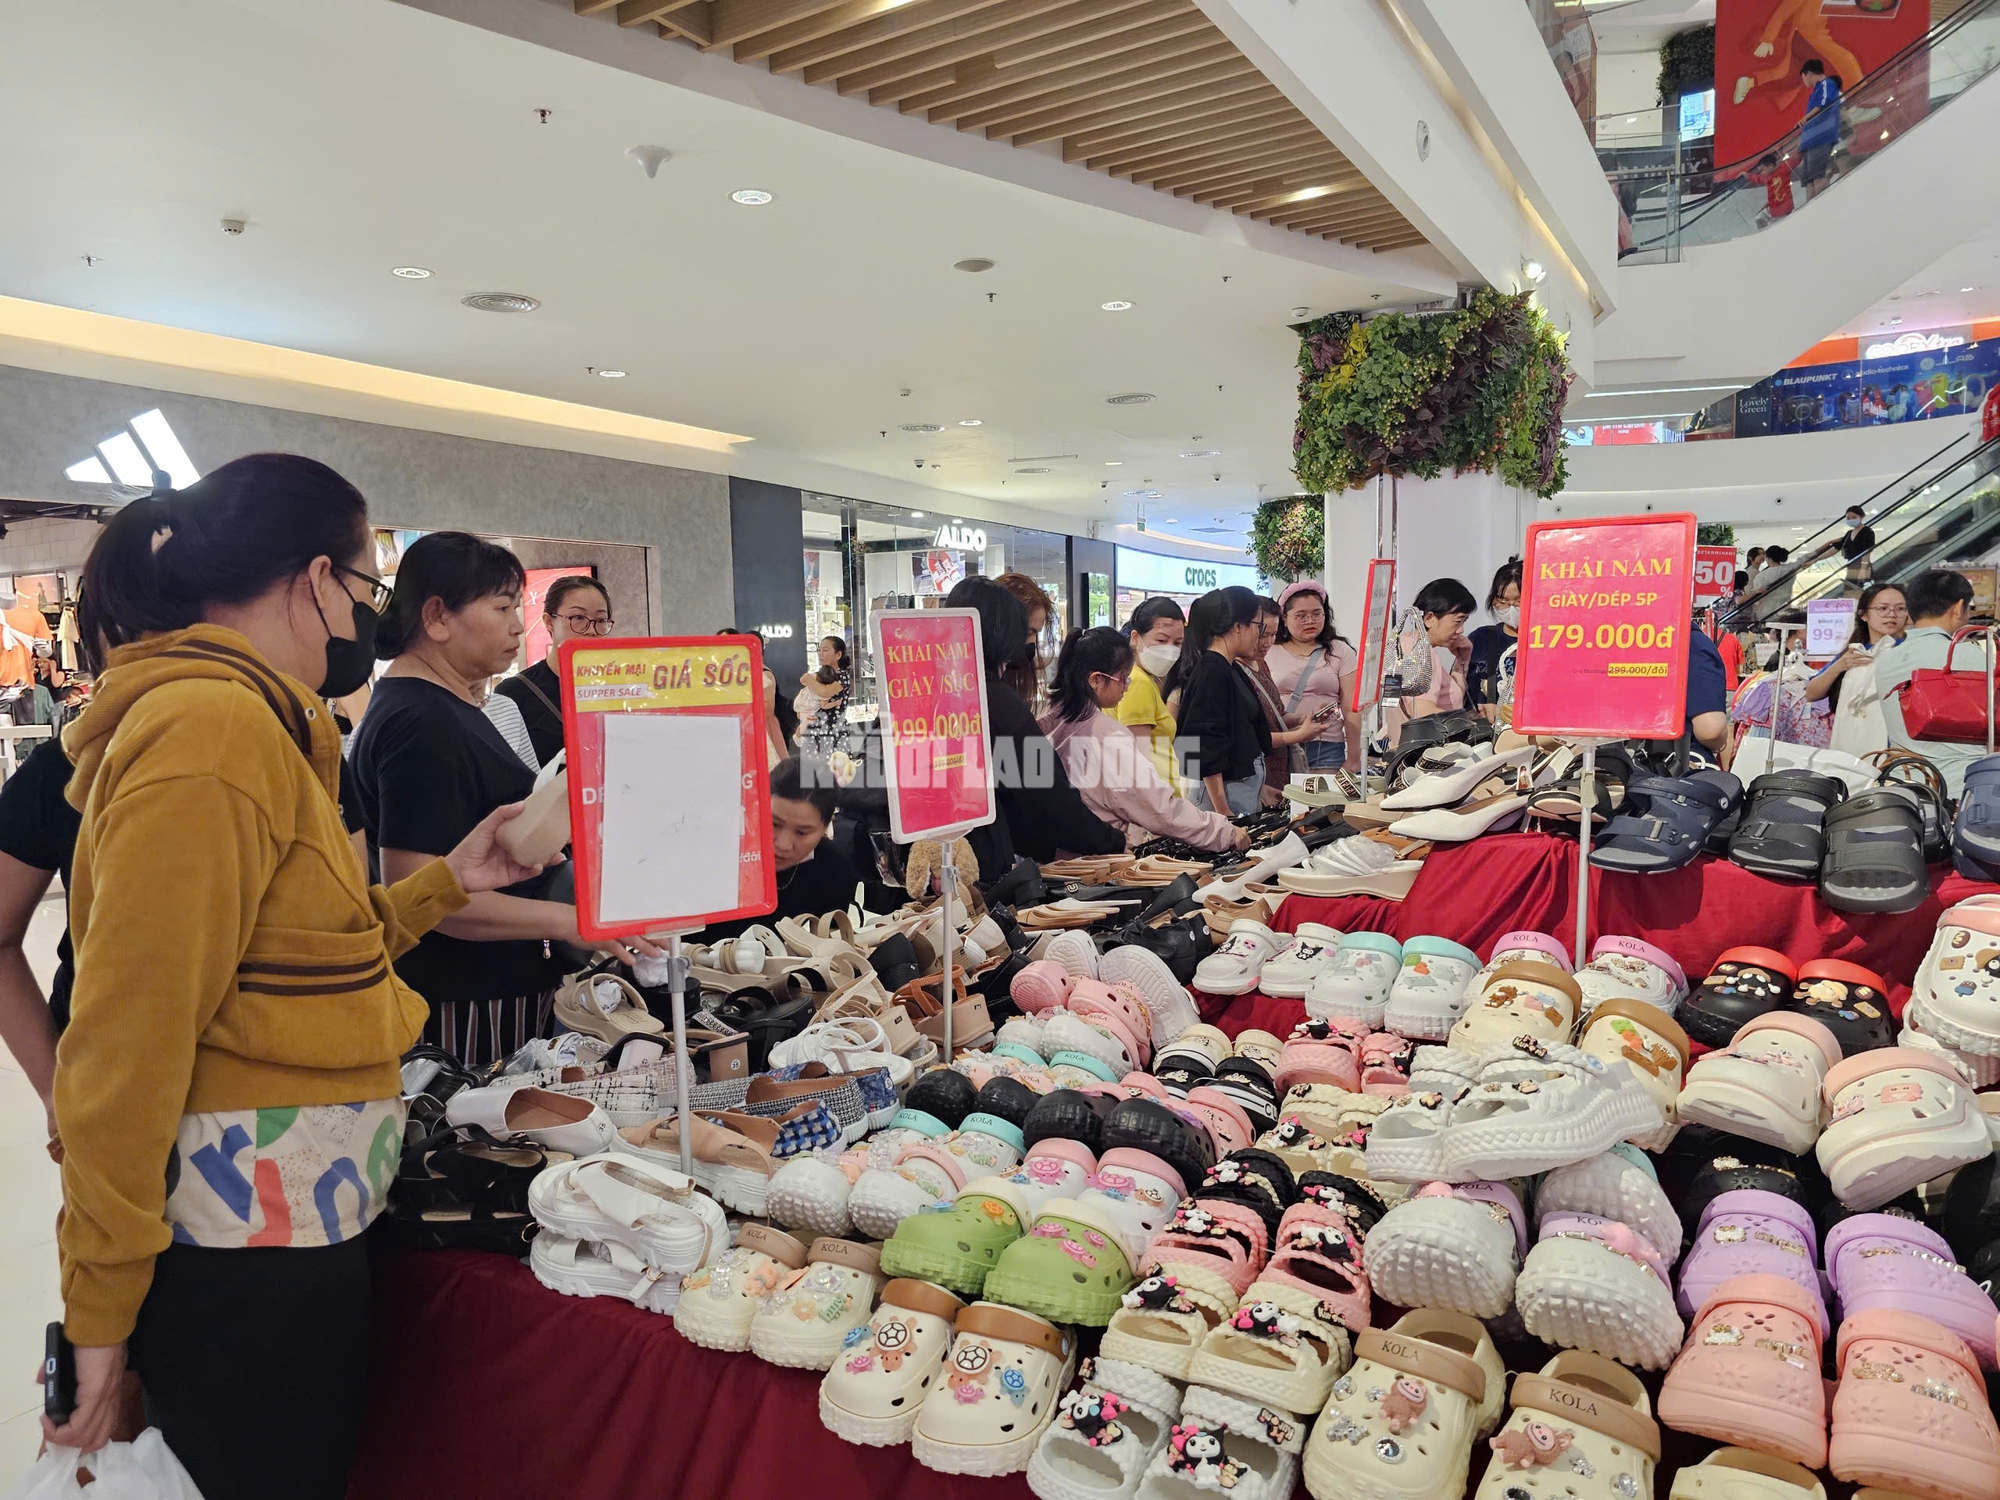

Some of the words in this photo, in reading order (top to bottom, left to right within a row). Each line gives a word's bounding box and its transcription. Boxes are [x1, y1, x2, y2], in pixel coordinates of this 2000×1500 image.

[1783, 373, 1838, 386] BLAUPUNKT
[1739, 397, 1767, 408] Lovely
[1740, 405, 1767, 414] Green
[935, 525, 986, 551] ALDO
[1540, 556, 1604, 580] KHẢI
[1611, 558, 1672, 577] NAM
[1695, 560, 1734, 585] 50
[1185, 567, 1217, 587] crocs
[1720, 586, 1734, 598] %
[1549, 590, 1631, 609] GIÀY/DÉP
[759, 625, 793, 638] ALDO
[1529, 623, 1676, 649] 179.000đ
[887, 640, 932, 664] KHẢI
[935, 642, 969, 660] NAM
[577, 661, 621, 677] KHUYẾN
[626, 663, 646, 677] MẠI
[653, 659, 692, 690] GIÁ
[703, 654, 749, 688] SỐC
[1608, 665, 1667, 676] 299.000/đôi
[888, 672, 935, 699] GIÀY
[577, 688, 616, 699] SUPPER
[619, 687, 642, 697] SALE
[1513, 934, 1539, 943] KOLA
[1618, 940, 1645, 953] KOLA
[1112, 981, 1134, 991] KOLA
[1064, 1053, 1085, 1062] KOLA
[898, 1112, 917, 1122] KOLA
[970, 1116, 993, 1126] KOLA
[746, 1228, 768, 1241] KOLA
[821, 1243, 848, 1255] KOLA
[1381, 1340, 1420, 1361] KOLA
[1549, 1388, 1599, 1416] KOLA
